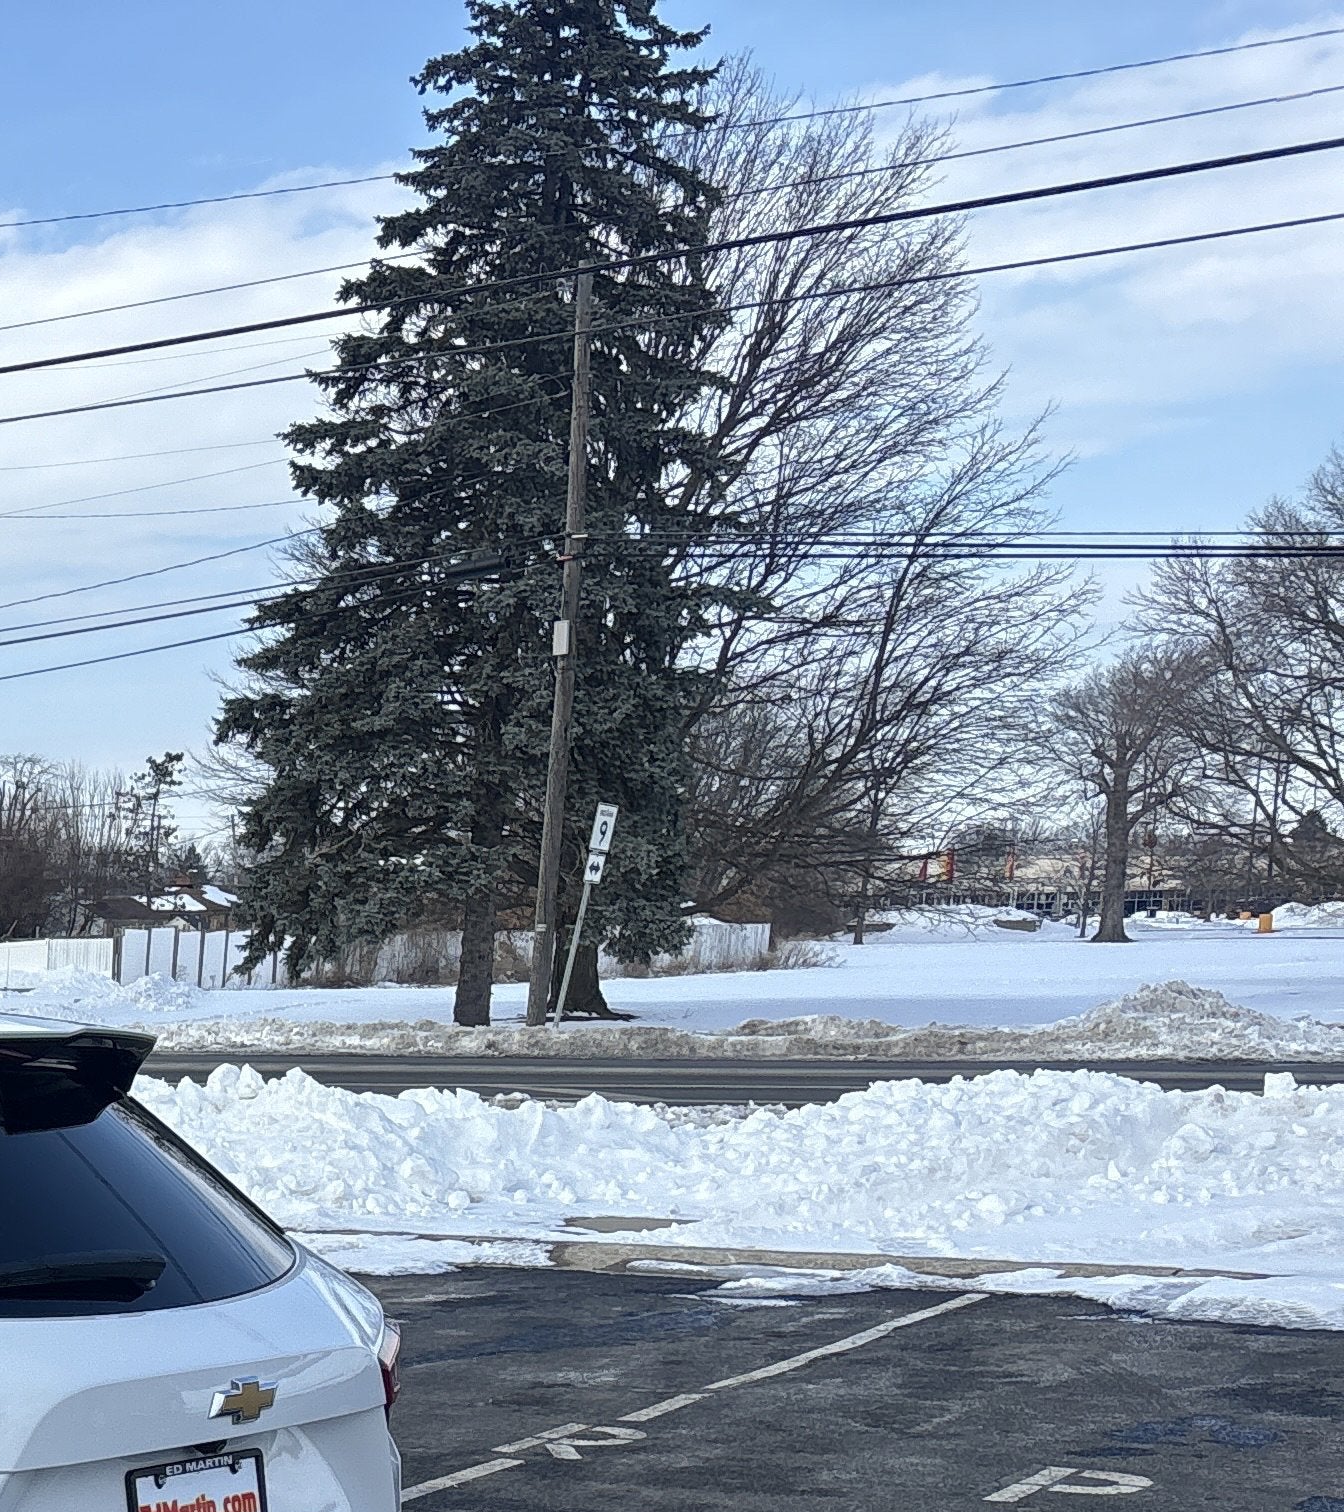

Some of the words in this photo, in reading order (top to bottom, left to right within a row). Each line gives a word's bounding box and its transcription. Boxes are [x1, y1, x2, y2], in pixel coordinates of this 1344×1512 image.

[599, 820, 609, 847] 9
[165, 1464, 183, 1476] ED
[185, 1454, 233, 1473] MARTIN
